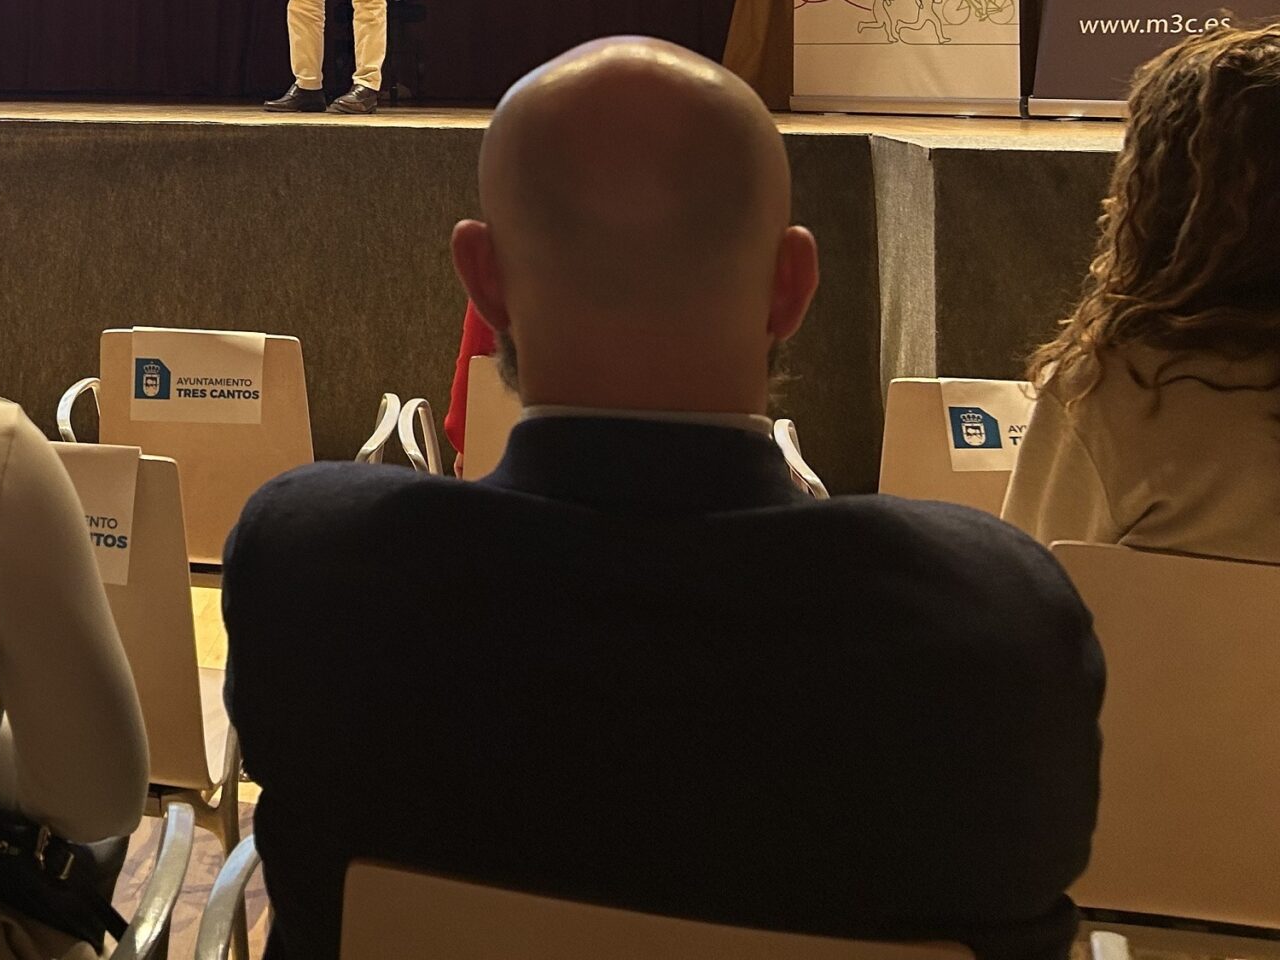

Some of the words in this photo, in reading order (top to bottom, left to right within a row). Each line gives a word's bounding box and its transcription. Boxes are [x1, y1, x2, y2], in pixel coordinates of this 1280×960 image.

[176, 376, 253, 388] AYUNTAMIENTO
[176, 388, 208, 399] TRES
[210, 389, 260, 401] CANTOS
